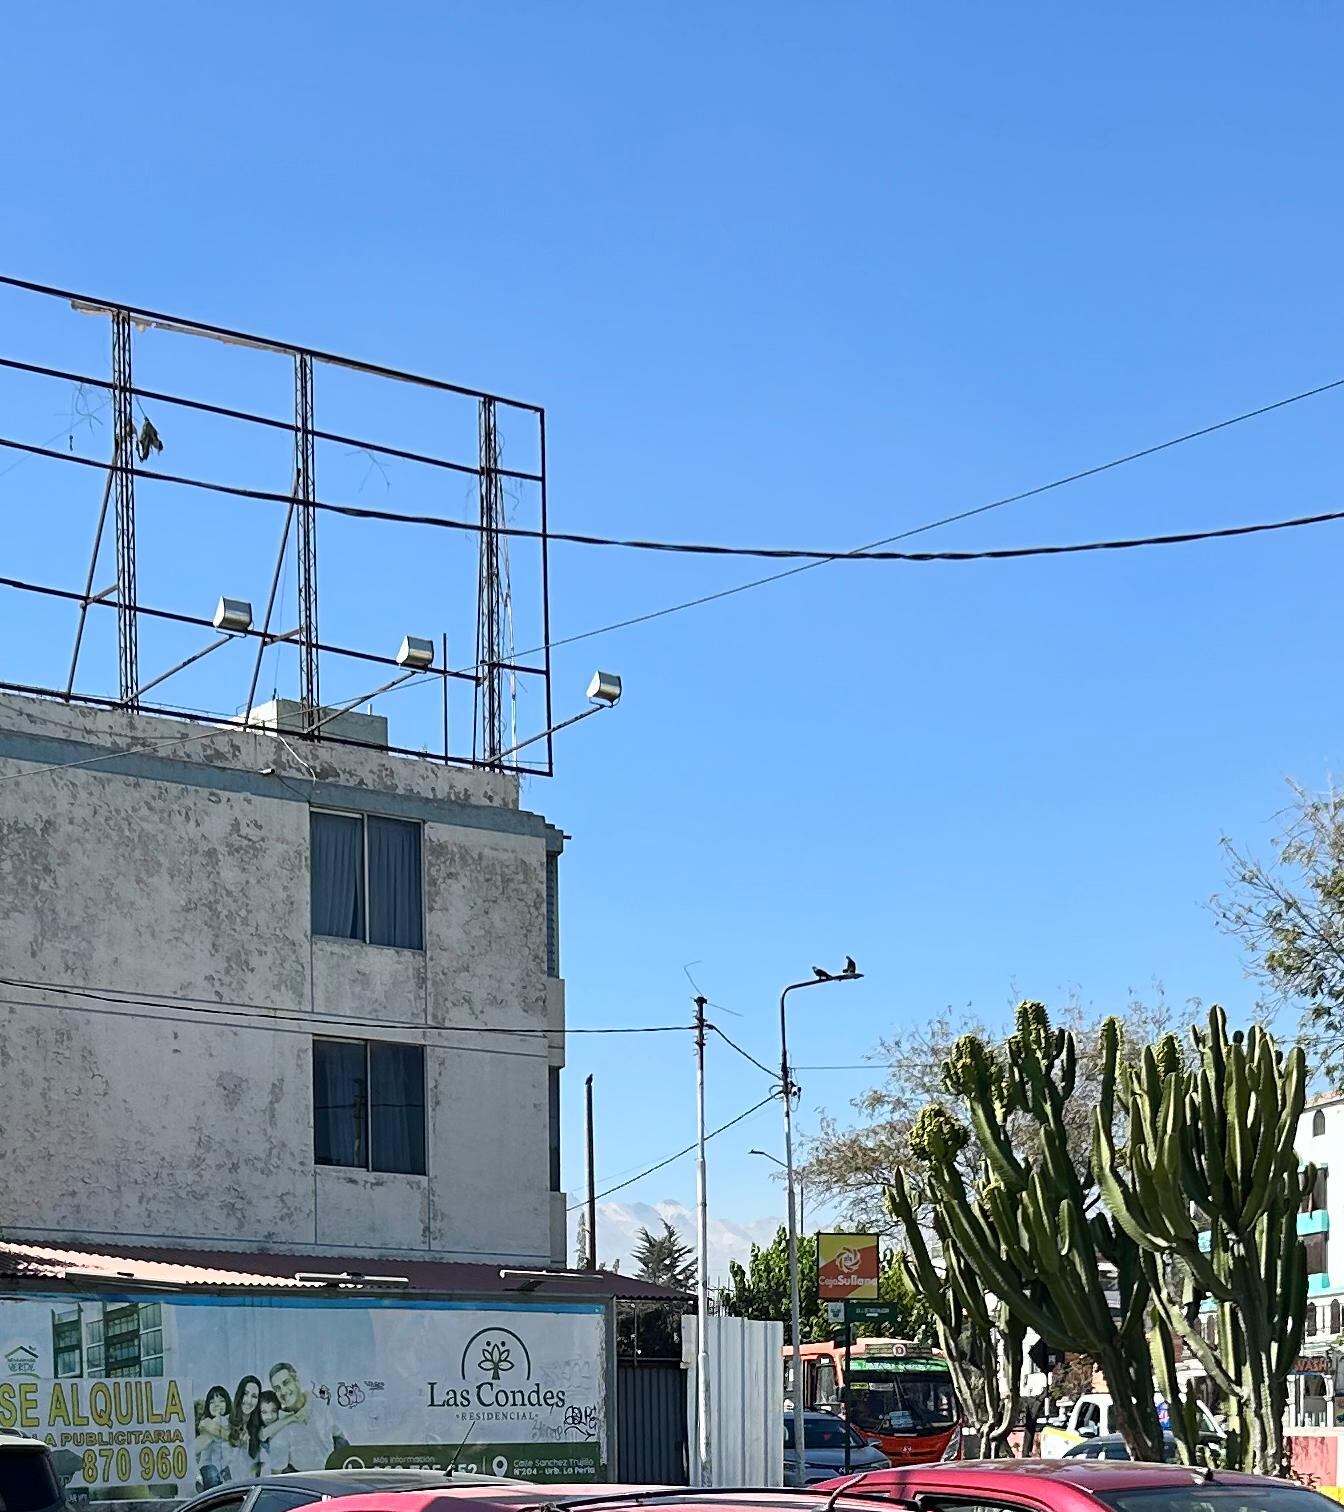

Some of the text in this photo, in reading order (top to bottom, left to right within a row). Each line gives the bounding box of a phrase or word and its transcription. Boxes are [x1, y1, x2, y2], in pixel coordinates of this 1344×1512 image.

[48, 1380, 186, 1429] ALQUILA
[427, 1381, 566, 1408] Las Condes
[61, 1429, 184, 1447] PUBLICITARIA
[82, 1445, 187, 1484] 870 960
